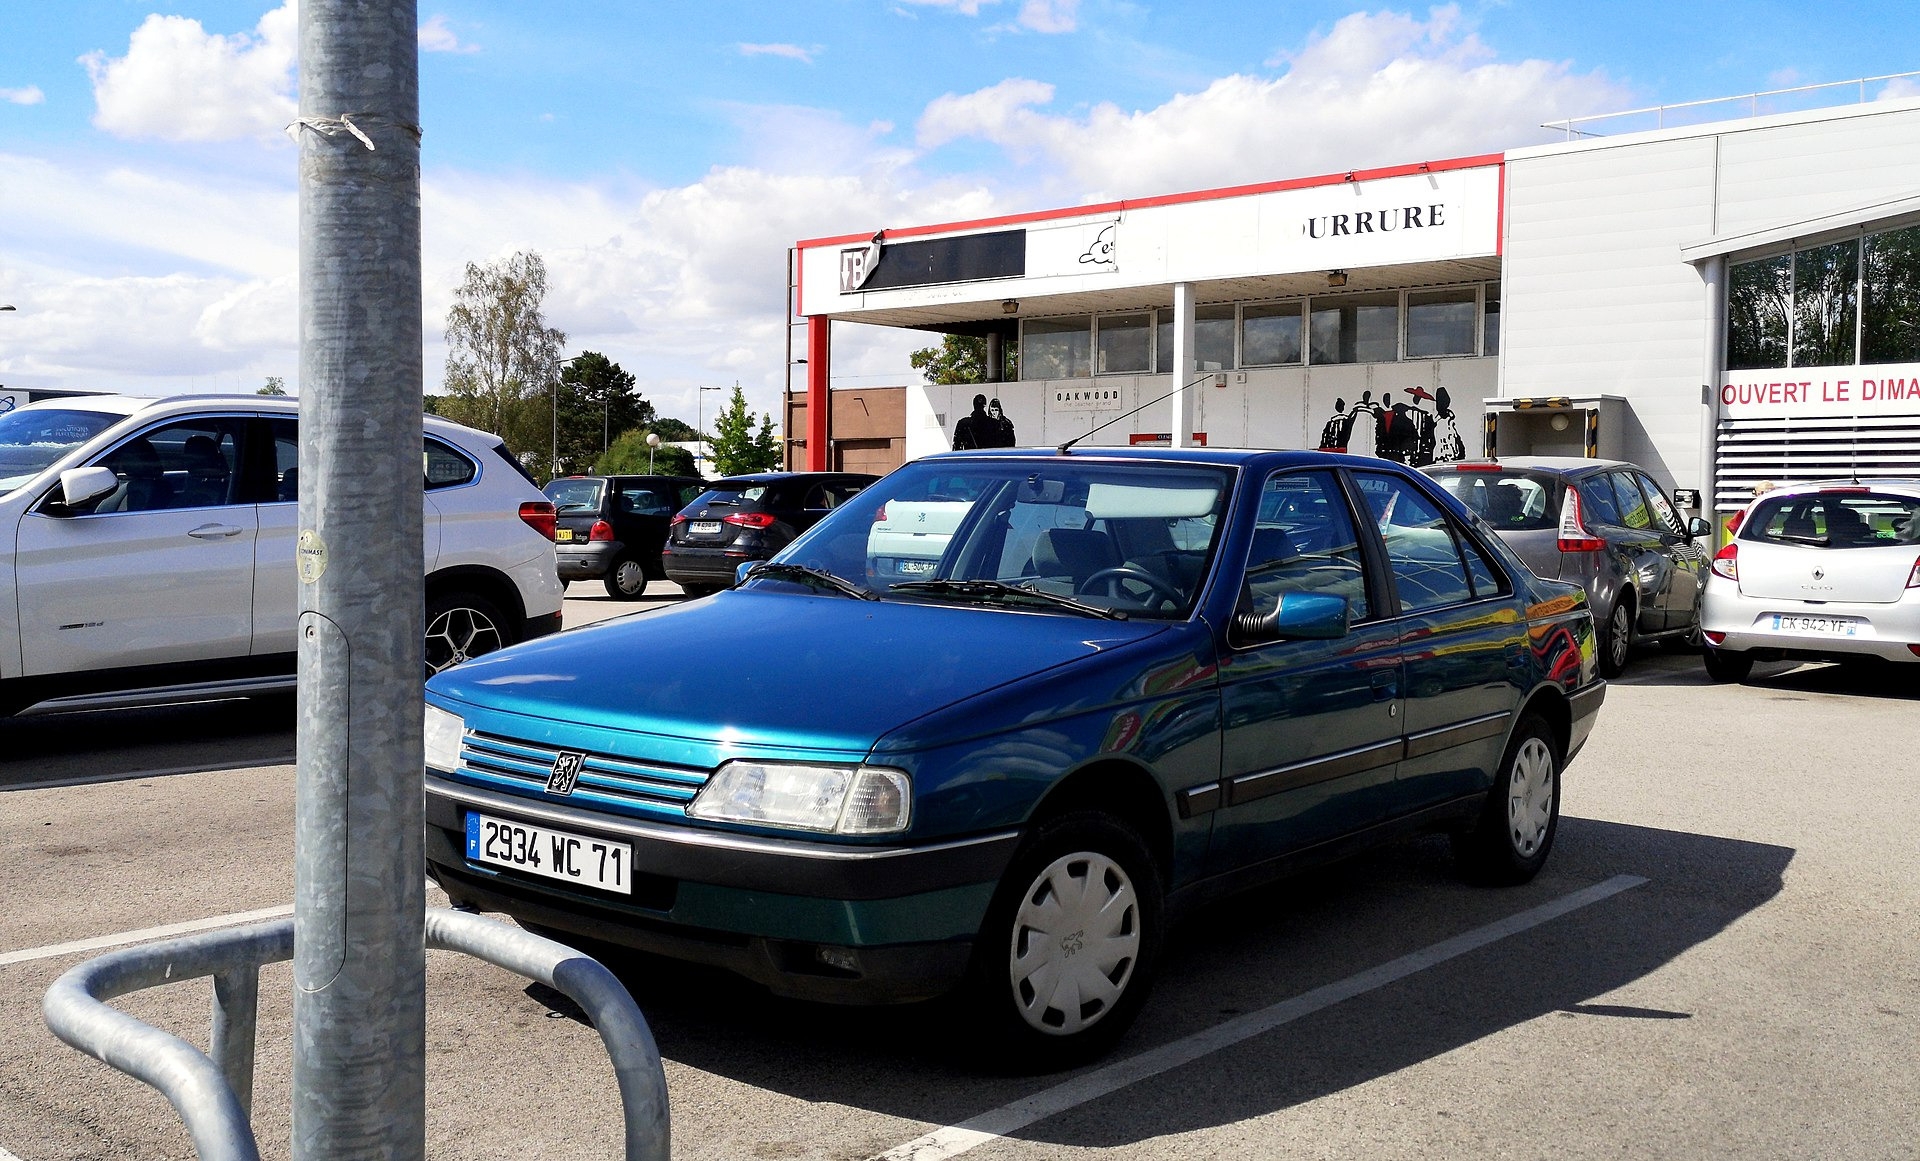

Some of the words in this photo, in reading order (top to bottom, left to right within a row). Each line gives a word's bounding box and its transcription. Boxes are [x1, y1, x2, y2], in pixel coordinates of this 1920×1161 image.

[1303, 203, 1445, 239] URRURE
[1056, 390, 1118, 402] OAKWOOD
[1721, 381, 1812, 405] OUVERT
[1822, 380, 1849, 402] LE
[470, 840, 476, 850] F
[486, 821, 541, 868] 2934
[551, 835, 581, 877] WC
[592, 843, 621, 886] 71
